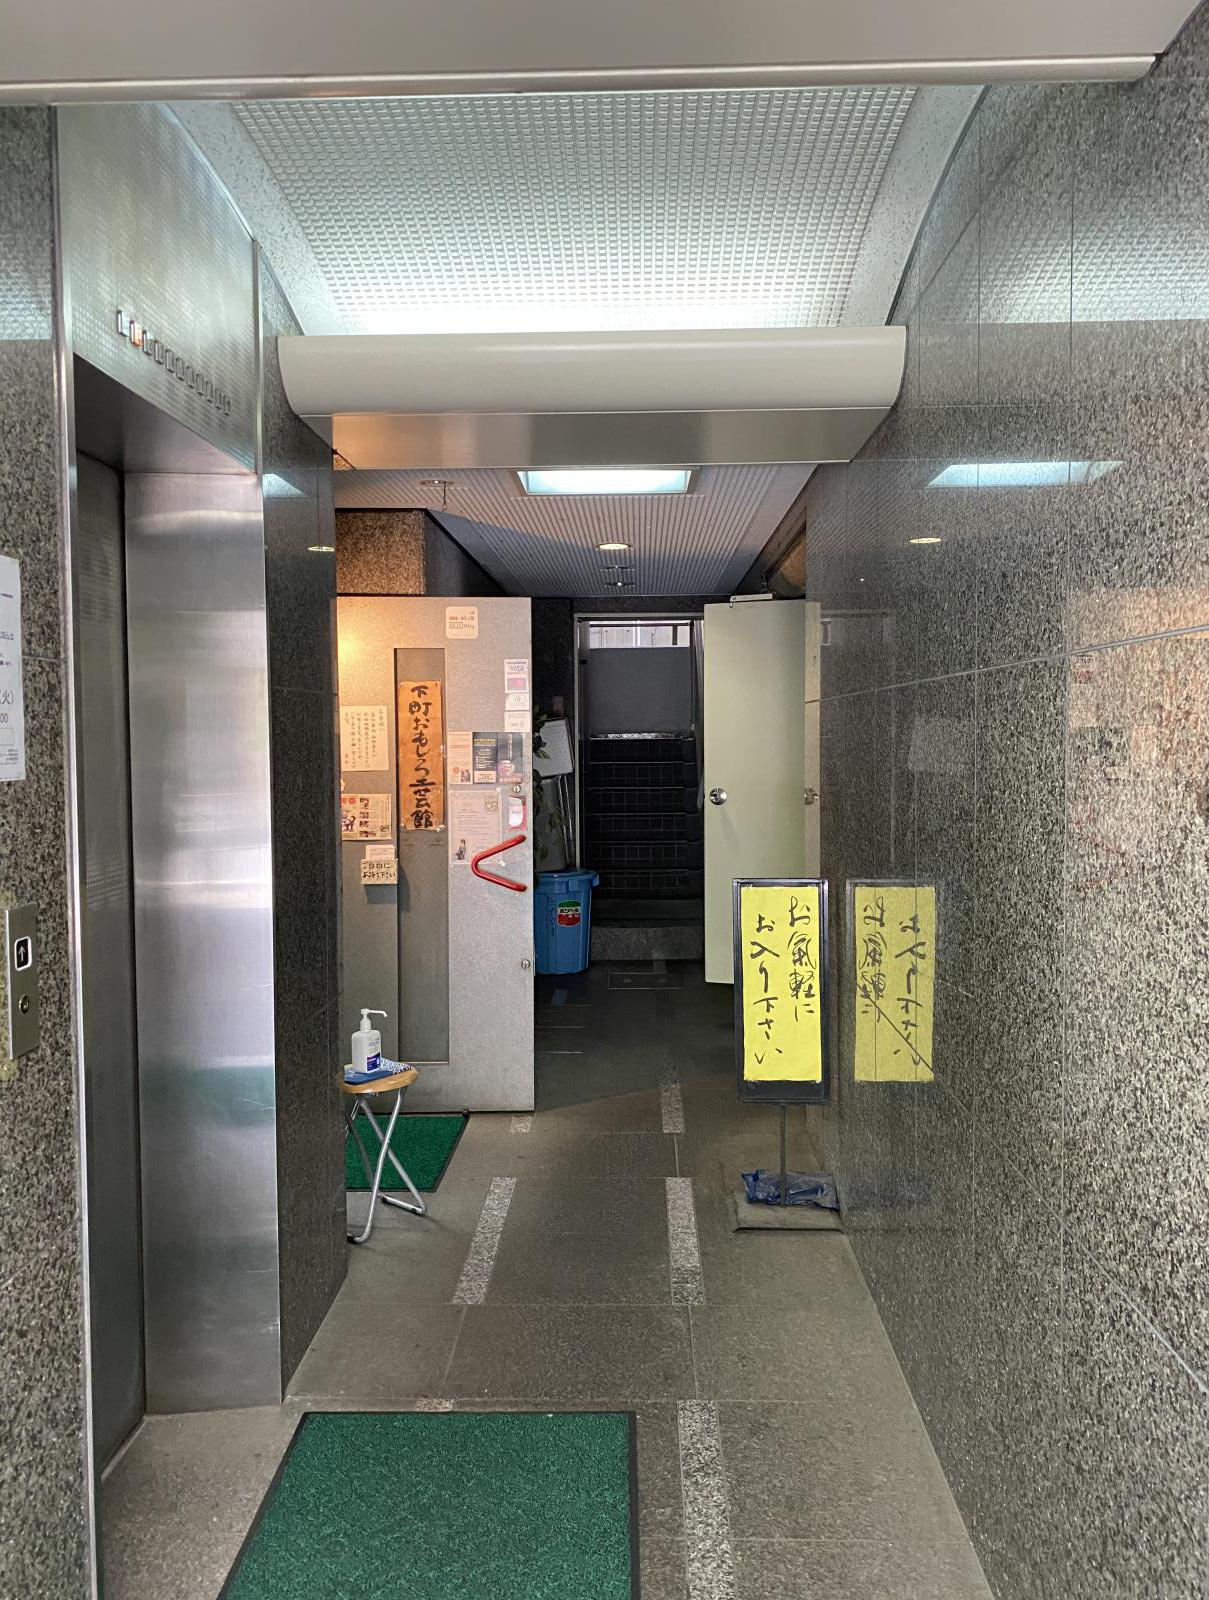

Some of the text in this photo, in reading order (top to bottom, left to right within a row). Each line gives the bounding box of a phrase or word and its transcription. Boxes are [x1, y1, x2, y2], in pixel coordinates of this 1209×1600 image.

[750, 914, 783, 1065] お入り下さい
